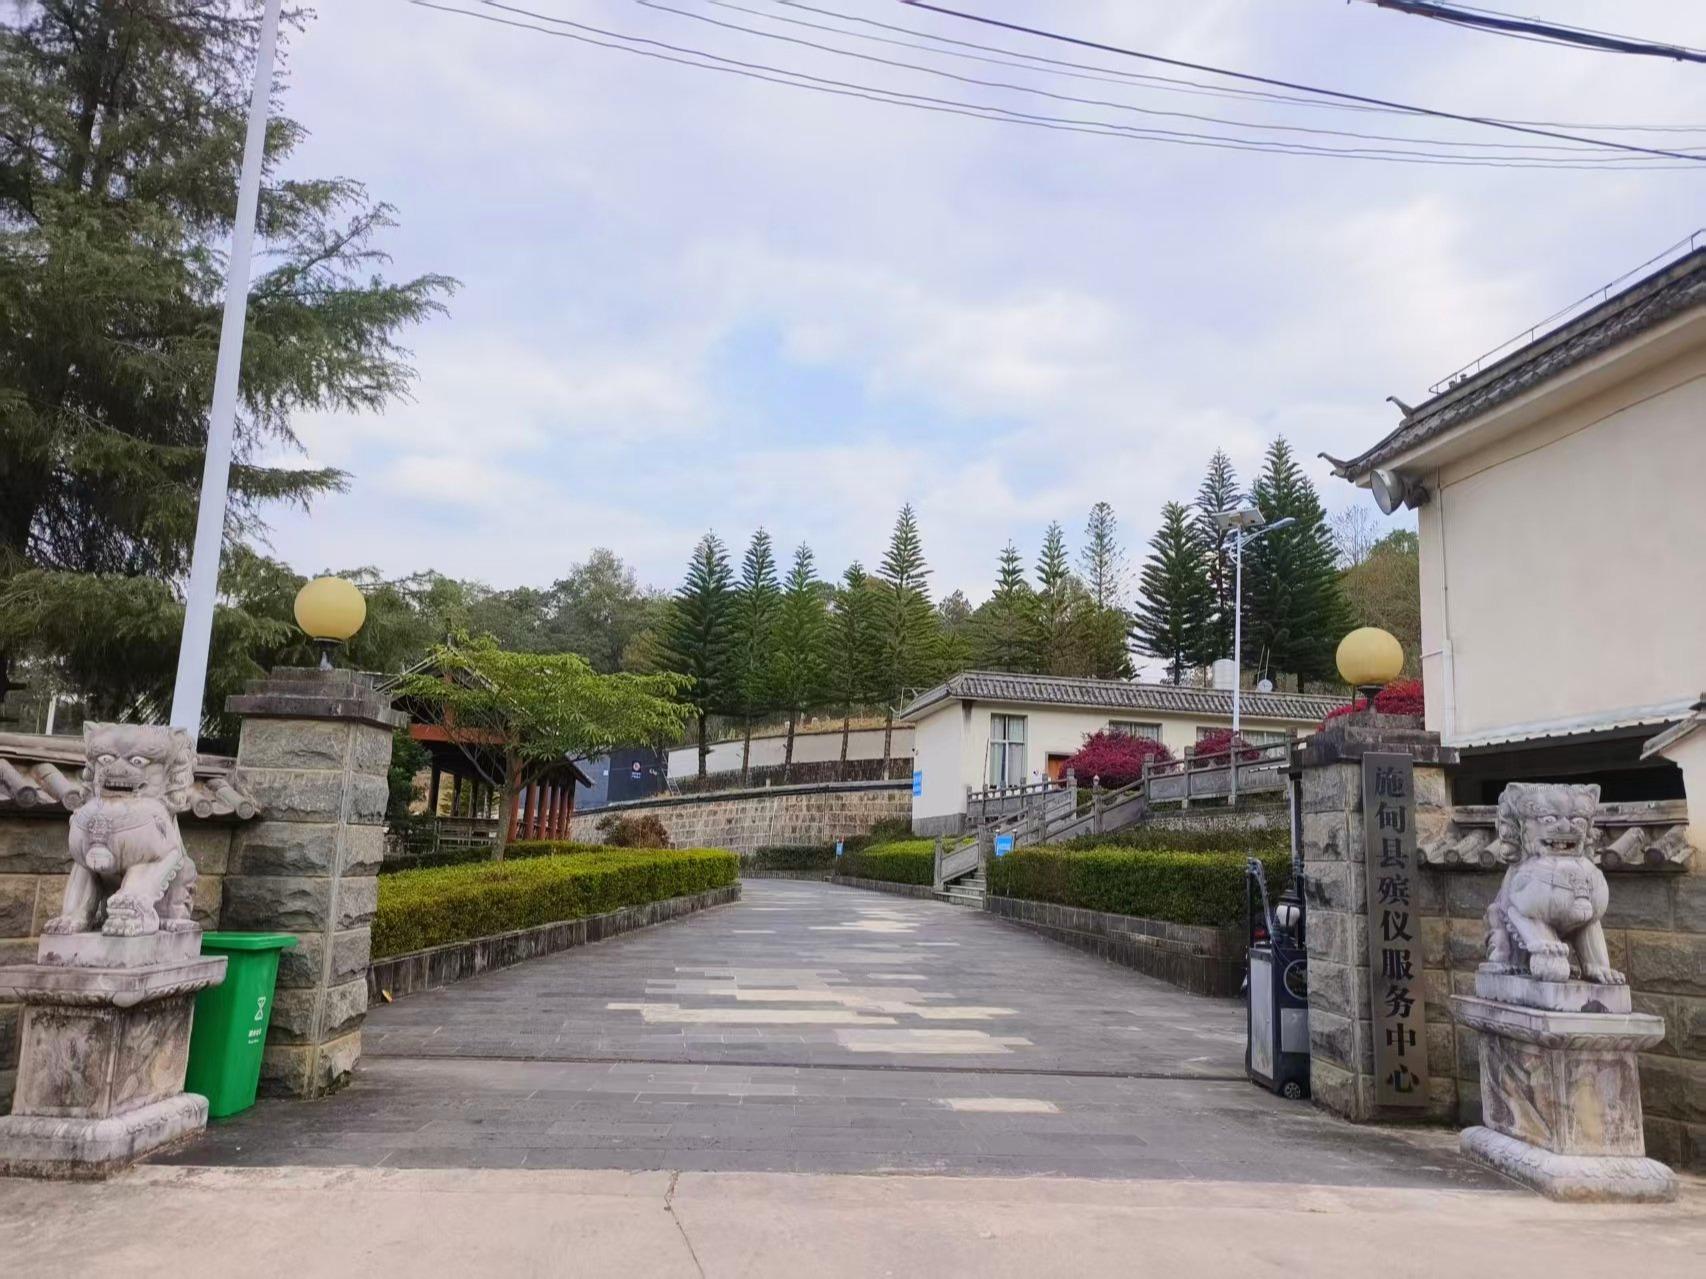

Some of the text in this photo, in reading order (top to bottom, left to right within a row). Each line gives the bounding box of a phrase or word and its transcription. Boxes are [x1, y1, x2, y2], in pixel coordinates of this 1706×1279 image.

[1375, 766, 1420, 1094] 施甸县殡仪服务中心
